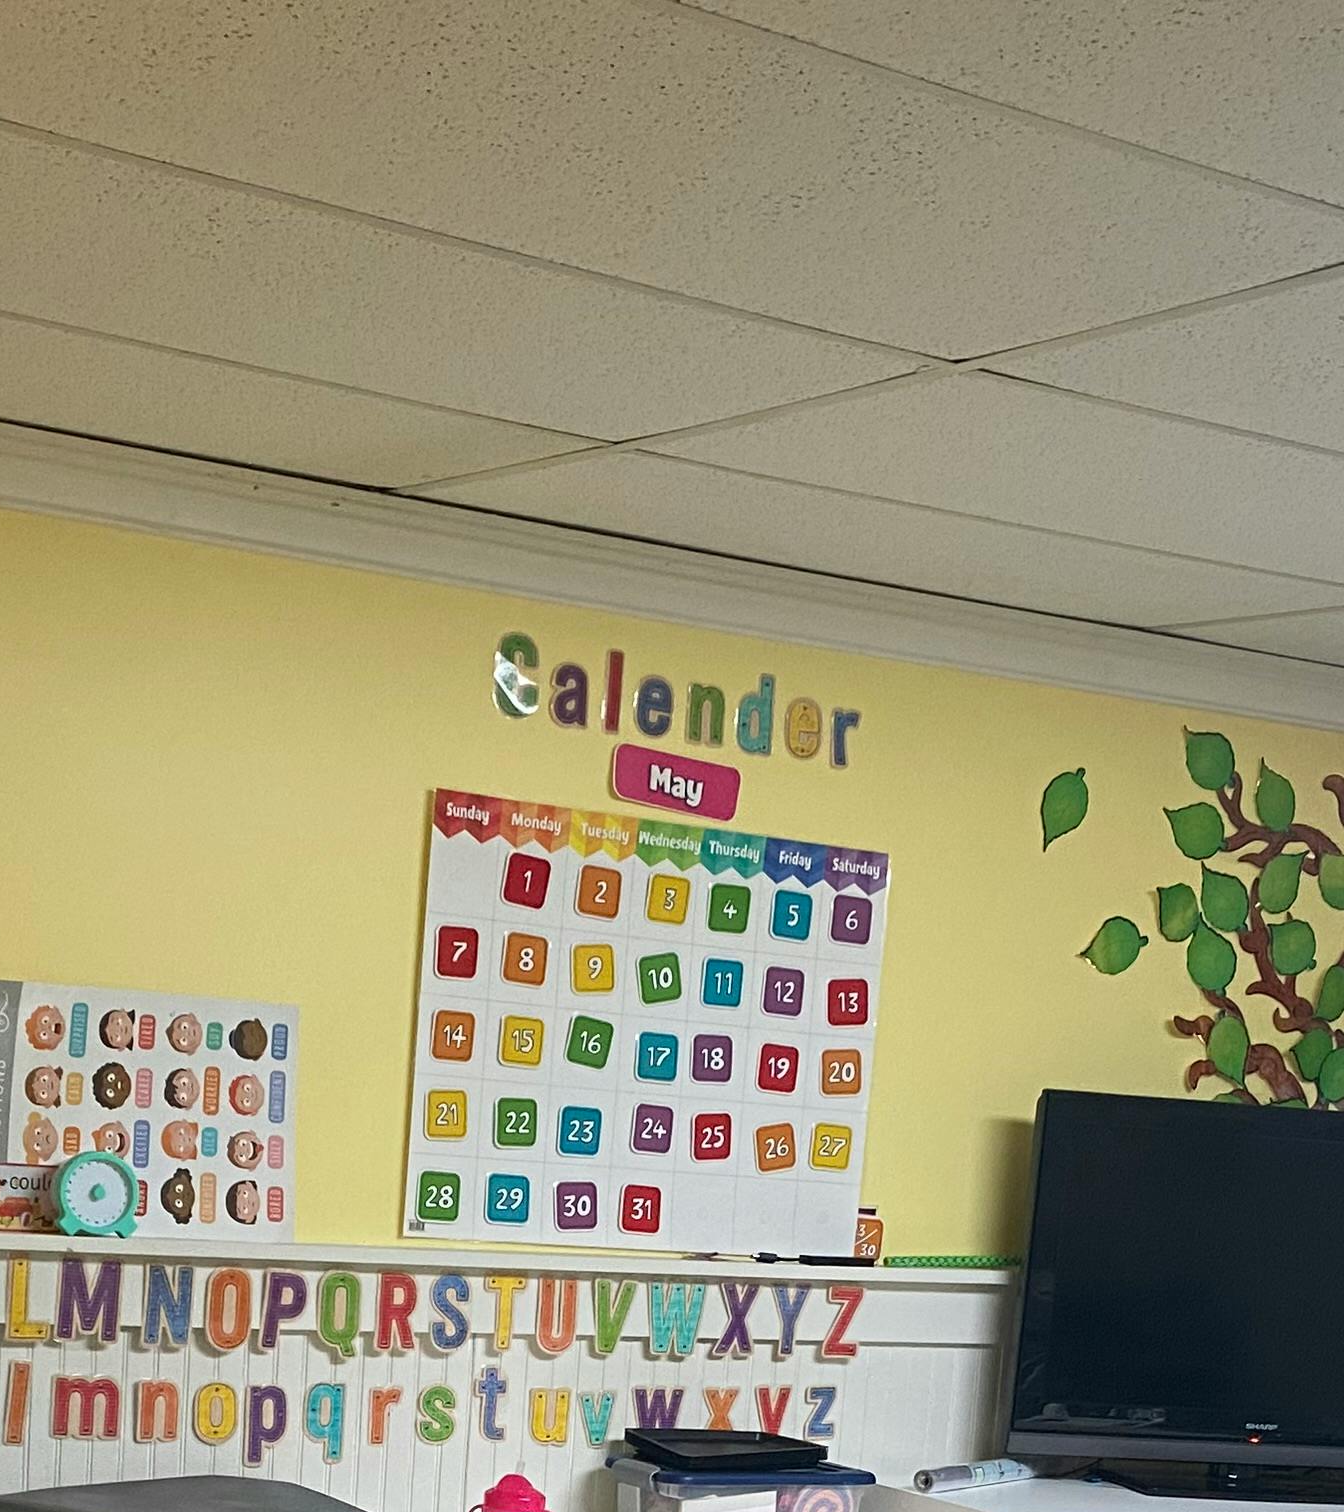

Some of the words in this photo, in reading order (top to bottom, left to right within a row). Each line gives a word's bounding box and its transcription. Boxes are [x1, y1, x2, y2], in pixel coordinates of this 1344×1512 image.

[491, 632, 862, 767] Calender
[649, 765, 704, 807] May
[446, 802, 491, 826] Sunday
[511, 813, 562, 836] Monday
[580, 821, 630, 844] Tuesday
[638, 830, 702, 856] Wednesday
[708, 840, 761, 864] Thursday
[778, 850, 813, 871] Friday
[831, 857, 881, 881] Saturday
[523, 870, 532, 893] 1
[594, 881, 607, 904] 2
[664, 889, 676, 911] 3
[722, 898, 739, 920] 4
[787, 904, 800, 927] 5
[845, 910, 858, 931] 6
[452, 941, 468, 962] 7
[518, 947, 534, 971] 8
[588, 956, 602, 979] 9
[648, 966, 673, 990] 10
[714, 972, 733, 994] 11
[774, 980, 795, 1003] 12
[837, 991, 859, 1013] 13
[139, 1015, 155, 1048] TIRED
[208, 1026, 222, 1048] SHY
[272, 1025, 287, 1058] PROUD
[443, 1024, 467, 1049] 14
[512, 1029, 534, 1053] 15
[580, 1030, 601, 1054] 16
[647, 1046, 671, 1067] 17
[701, 1047, 725, 1071] 18
[768, 1056, 790, 1080] 19
[829, 1061, 856, 1083] 20
[136, 1070, 153, 1106] SCARED
[204, 1069, 219, 1112] WORRIED
[64, 1132, 78, 1152] SAD
[134, 1124, 149, 1164] EXCITED
[436, 1103, 457, 1125] 21
[505, 1111, 530, 1134] 22
[567, 1119, 595, 1143] 23
[641, 1117, 667, 1139] 24
[701, 1125, 725, 1149] 25
[765, 1136, 789, 1160] 26
[819, 1135, 846, 1156] 27
[269, 1189, 282, 1220] BORED
[425, 1185, 454, 1209] 28
[495, 1187, 524, 1210] 29
[563, 1194, 591, 1217] 30
[630, 1197, 652, 1220] 31
